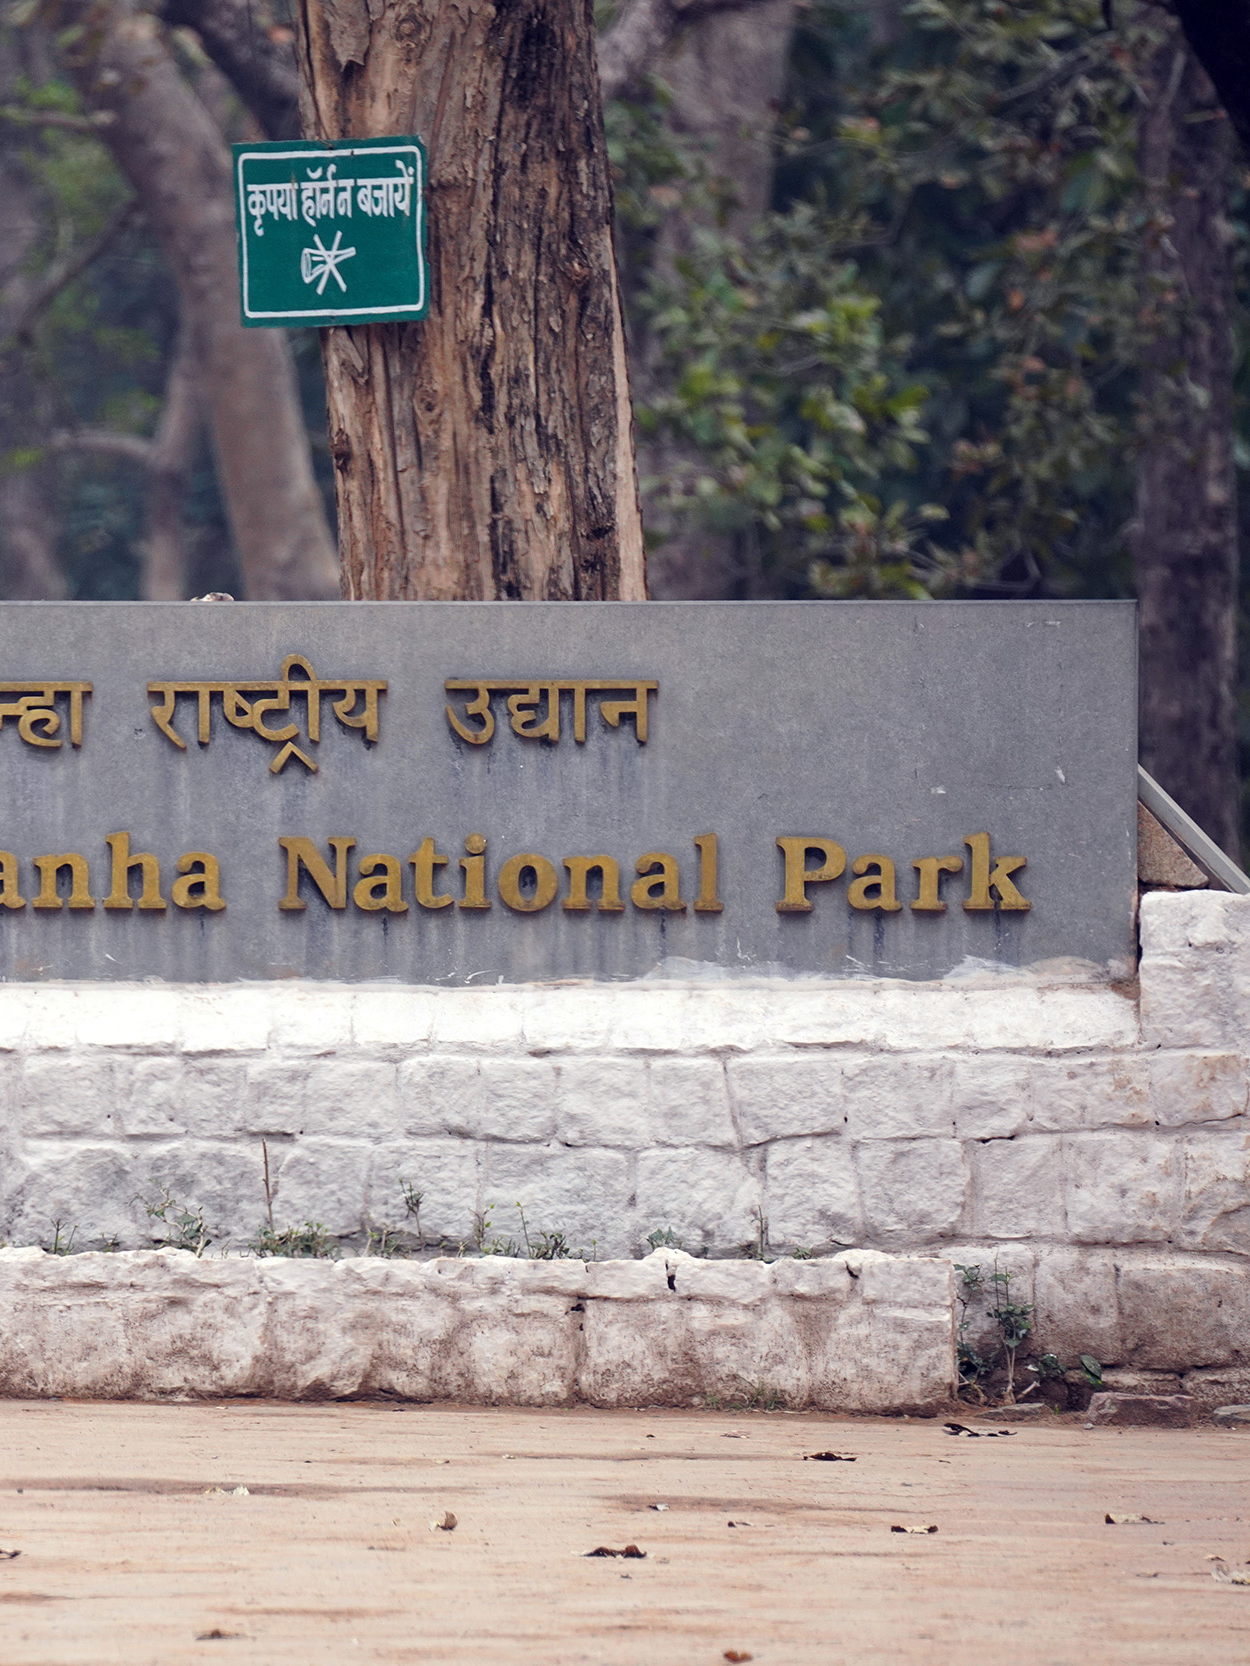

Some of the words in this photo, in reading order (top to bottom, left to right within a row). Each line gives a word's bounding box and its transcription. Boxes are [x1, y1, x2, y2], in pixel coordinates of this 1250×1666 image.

[247, 182, 298, 236] कृपया
[301, 163, 337, 227] हॉर्न
[337, 178, 354, 218] न
[357, 159, 414, 218] बजायें
[148, 653, 388, 774] राष्ट्रीय
[444, 679, 659, 745] उद्यान
[277, 833, 725, 913] National
[775, 832, 1032, 912] Park
